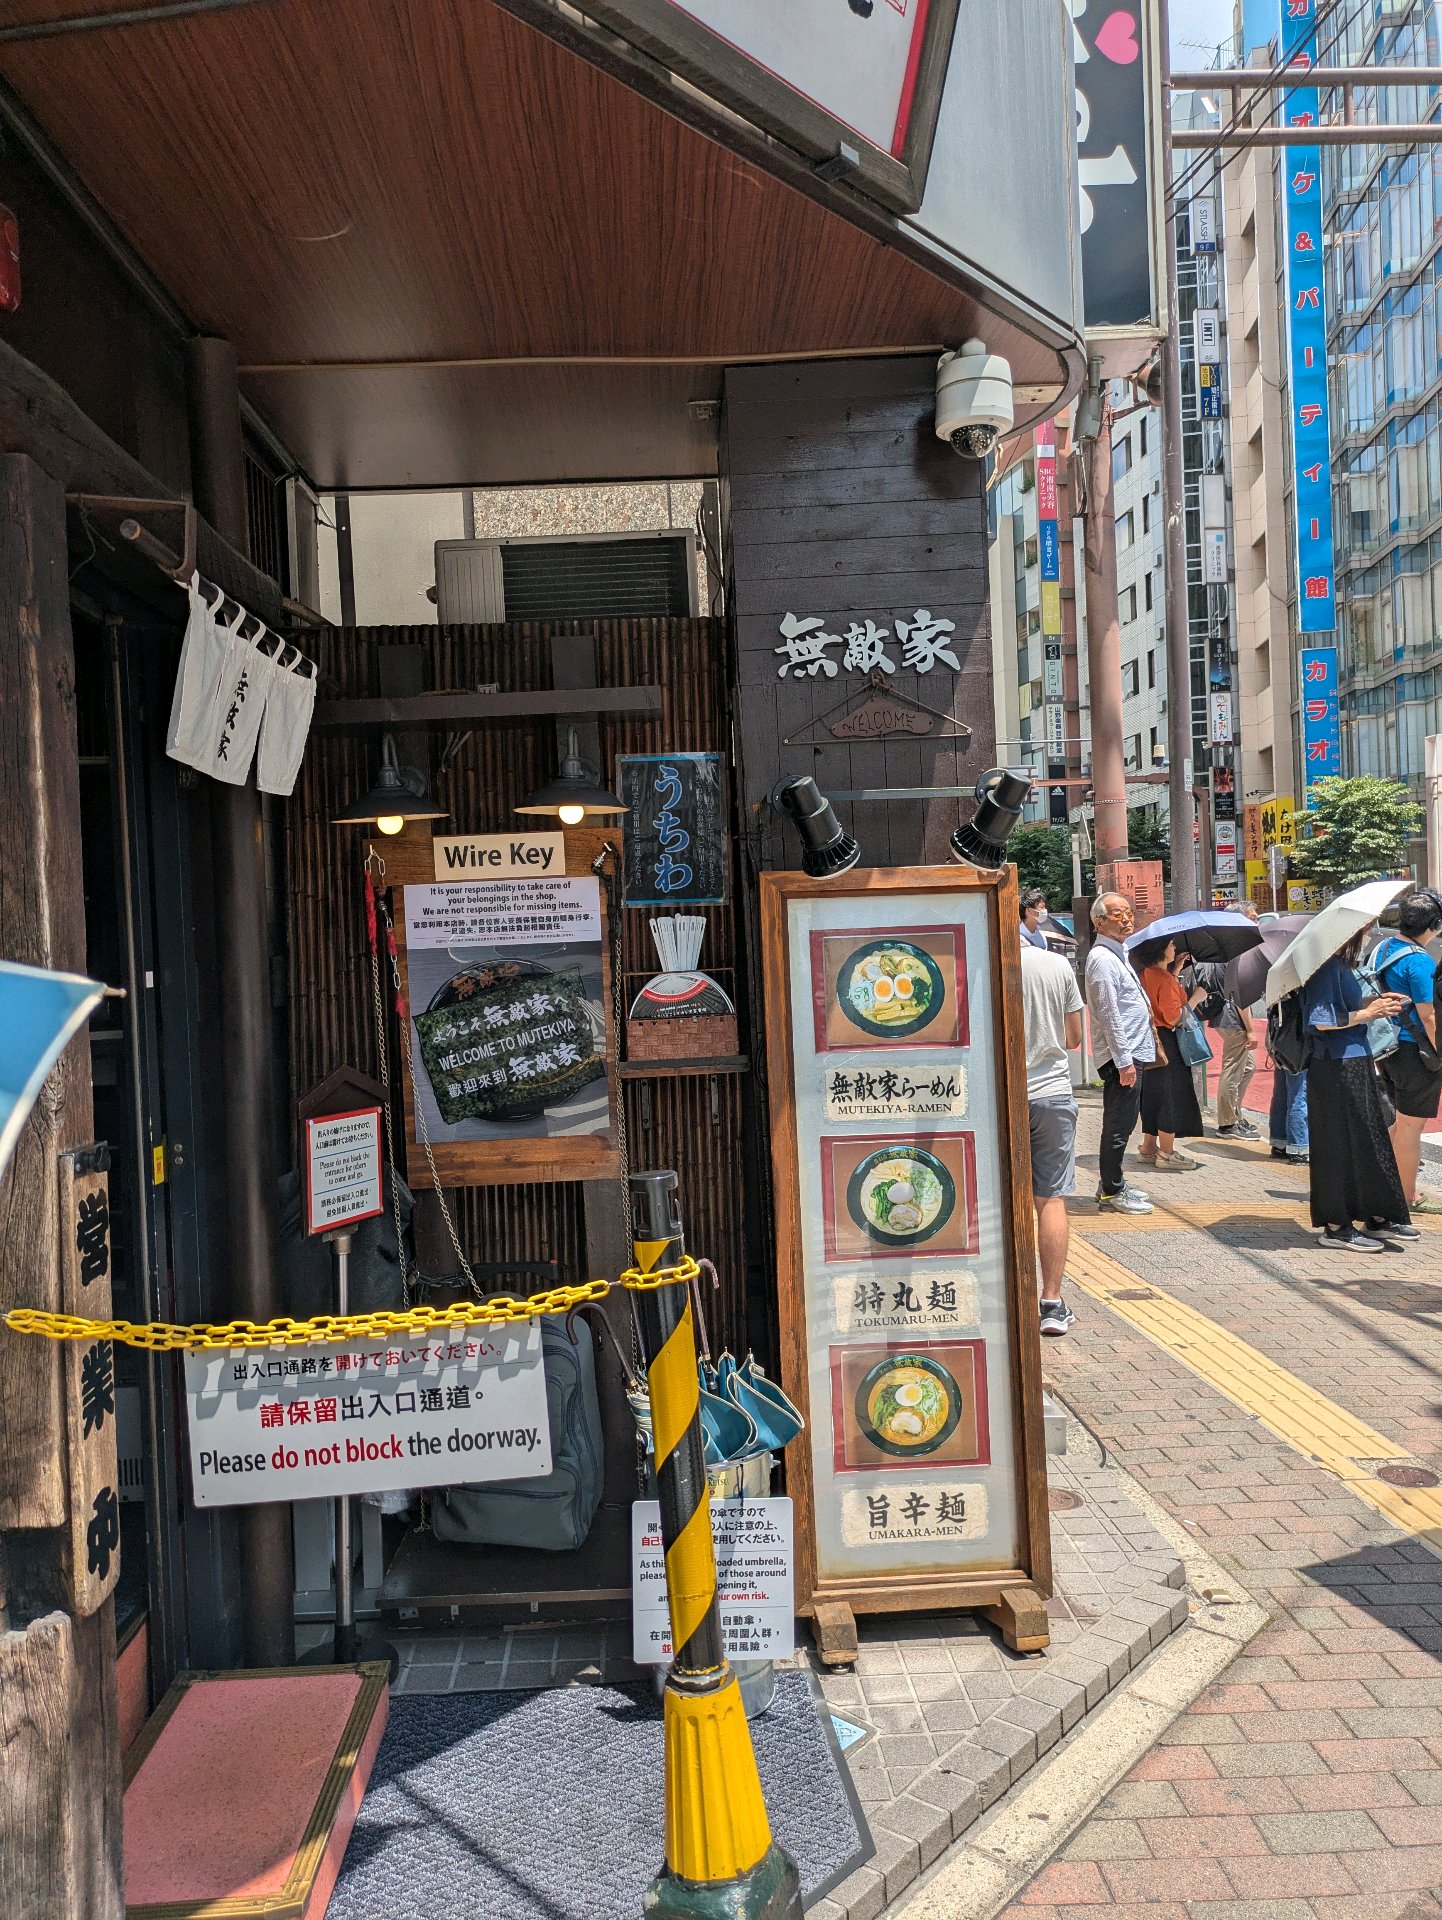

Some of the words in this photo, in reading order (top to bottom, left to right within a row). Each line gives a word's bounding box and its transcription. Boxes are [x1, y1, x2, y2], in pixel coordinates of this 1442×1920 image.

[775, 609, 961, 678] 無敵家
[842, 710, 916, 738] WELCOME
[652, 764, 693, 893] うちわ
[444, 844, 502, 868] Wire
[510, 843, 554, 870] Key
[430, 887, 438, 896] It
[438, 886, 444, 894] is
[446, 887, 463, 896] your
[464, 884, 516, 896] responsibility
[518, 884, 526, 892] to
[527, 883, 544, 891] take
[562, 881, 572, 889] of
[448, 896, 465, 906] your
[468, 894, 510, 904] belongings
[520, 892, 534, 901] the
[536, 892, 556, 902] shop.
[422, 908, 435, 916] We
[451, 906, 464, 914] not
[466, 903, 512, 914] responsible
[513, 902, 525, 911] for
[526, 901, 556, 911] missing
[558, 900, 582, 909] items.
[432, 994, 569, 1044] ようこそ無敵家へ
[438, 1046, 498, 1072] WELCOME
[499, 1036, 516, 1052] TO
[517, 1018, 576, 1047] MUTEKIYA
[830, 1070, 961, 1104] 無敵家らーめん
[838, 1102, 952, 1116] MUTEKIYA-RAMEN
[320, 1161, 334, 1170] Please
[336, 1158, 342, 1166] do
[350, 1153, 362, 1162] block
[362, 1152, 370, 1160] the
[324, 1168, 344, 1178] entrance
[353, 1162, 366, 1170] others
[334, 1176, 346, 1184] come
[348, 1172, 356, 1180] and
[854, 1280, 958, 1316] 特丸麺
[854, 1313, 958, 1328] TOKUMARU-MEN
[233, 1342, 502, 1381] 出入口通路を開けておいてください。
[76, 1188, 120, 1582] 営業中
[260, 1385, 483, 1428] 請保留出入口通道。
[200, 1450, 266, 1476] Please
[271, 1444, 299, 1470] do
[304, 1442, 341, 1468] not
[346, 1434, 404, 1464] block
[408, 1431, 442, 1457] the
[447, 1426, 542, 1455] doorway.
[866, 1490, 968, 1529] 旨辛麺
[868, 1524, 963, 1540] UMAKARA-MEN
[640, 1560, 650, 1568] As
[744, 1557, 787, 1567] umbrella,
[718, 1570, 729, 1578] of
[730, 1569, 754, 1578] those
[755, 1568, 787, 1577] around
[717, 1580, 747, 1591] pening
[748, 1580, 758, 1590] it,
[658, 1594, 668, 1602] an
[751, 1592, 770, 1600] risk.
